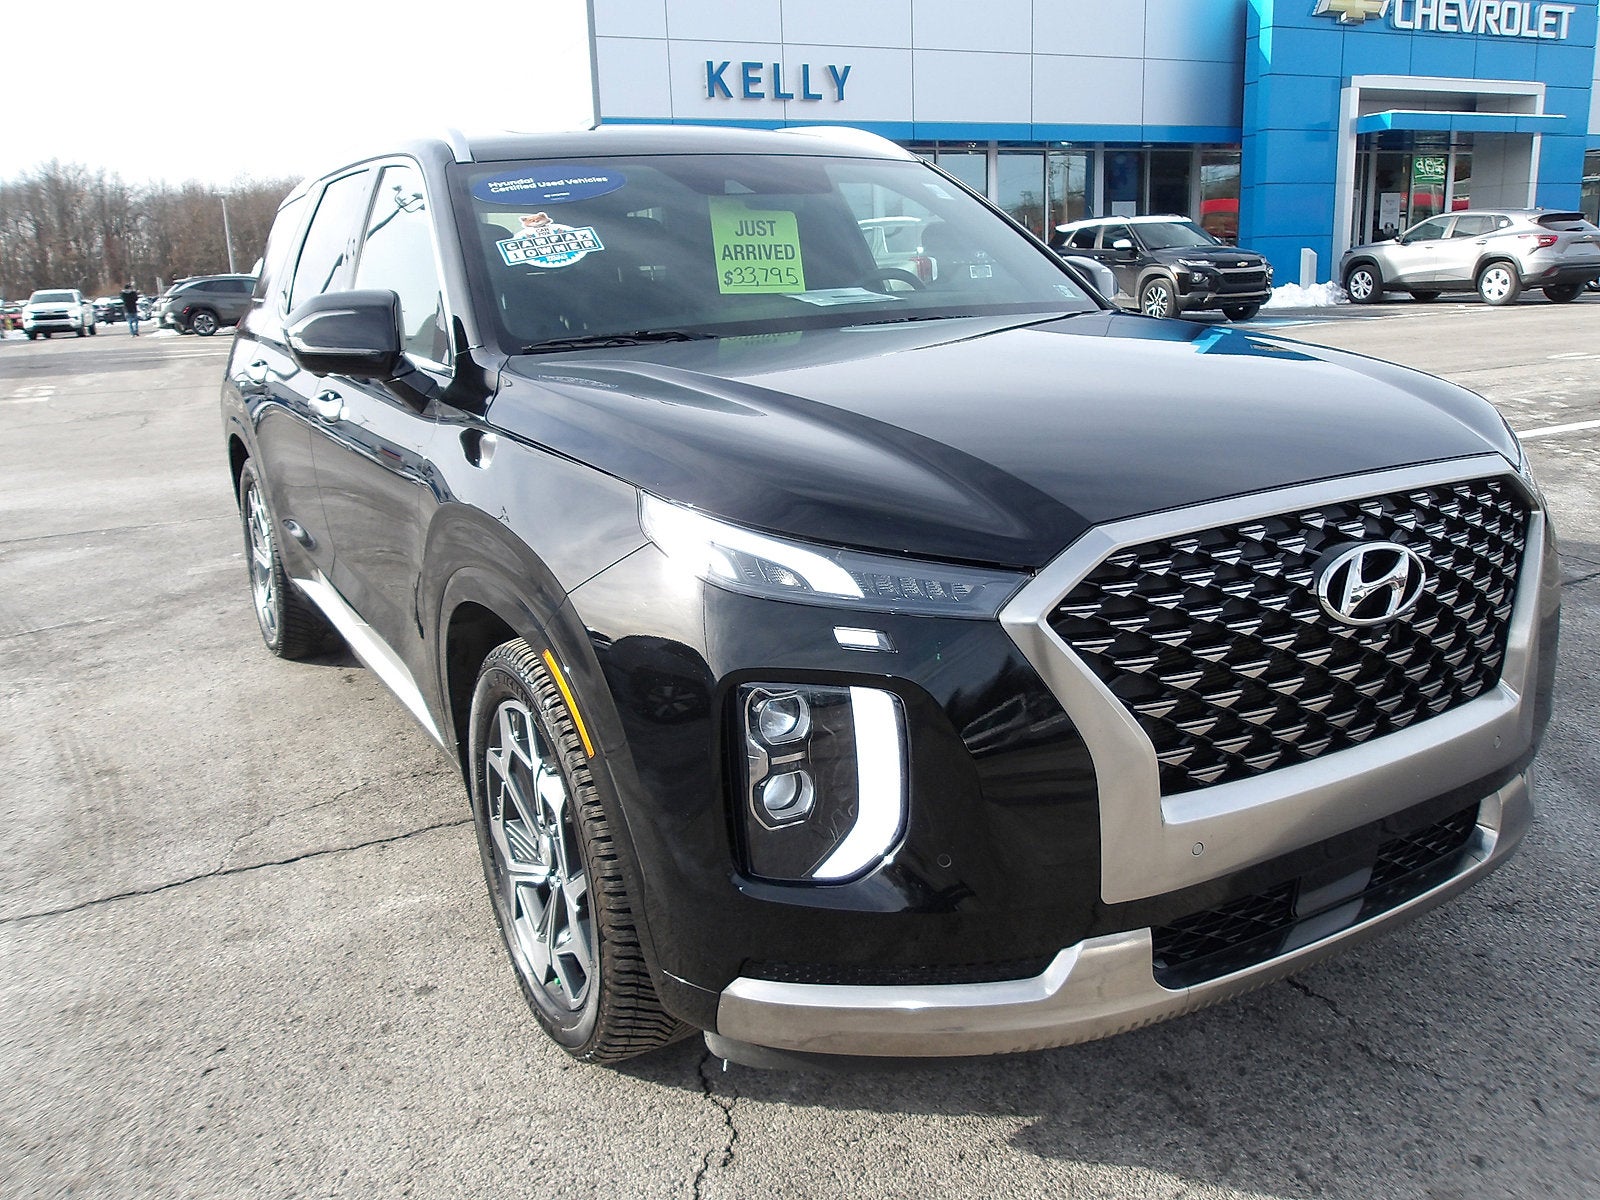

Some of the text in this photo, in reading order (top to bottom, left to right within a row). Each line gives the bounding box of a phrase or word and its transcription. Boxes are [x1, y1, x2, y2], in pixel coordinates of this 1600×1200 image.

[1393, 0, 1575, 40] CHEVROLET
[705, 60, 852, 102] KELLY
[488, 178, 534, 188] Hyundai
[490, 176, 608, 193] Certified Used Vehicles
[735, 220, 776, 237] JUST
[504, 233, 589, 252] CARFAX
[721, 244, 796, 261] ARRIVED
[724, 266, 800, 287] $33,795
